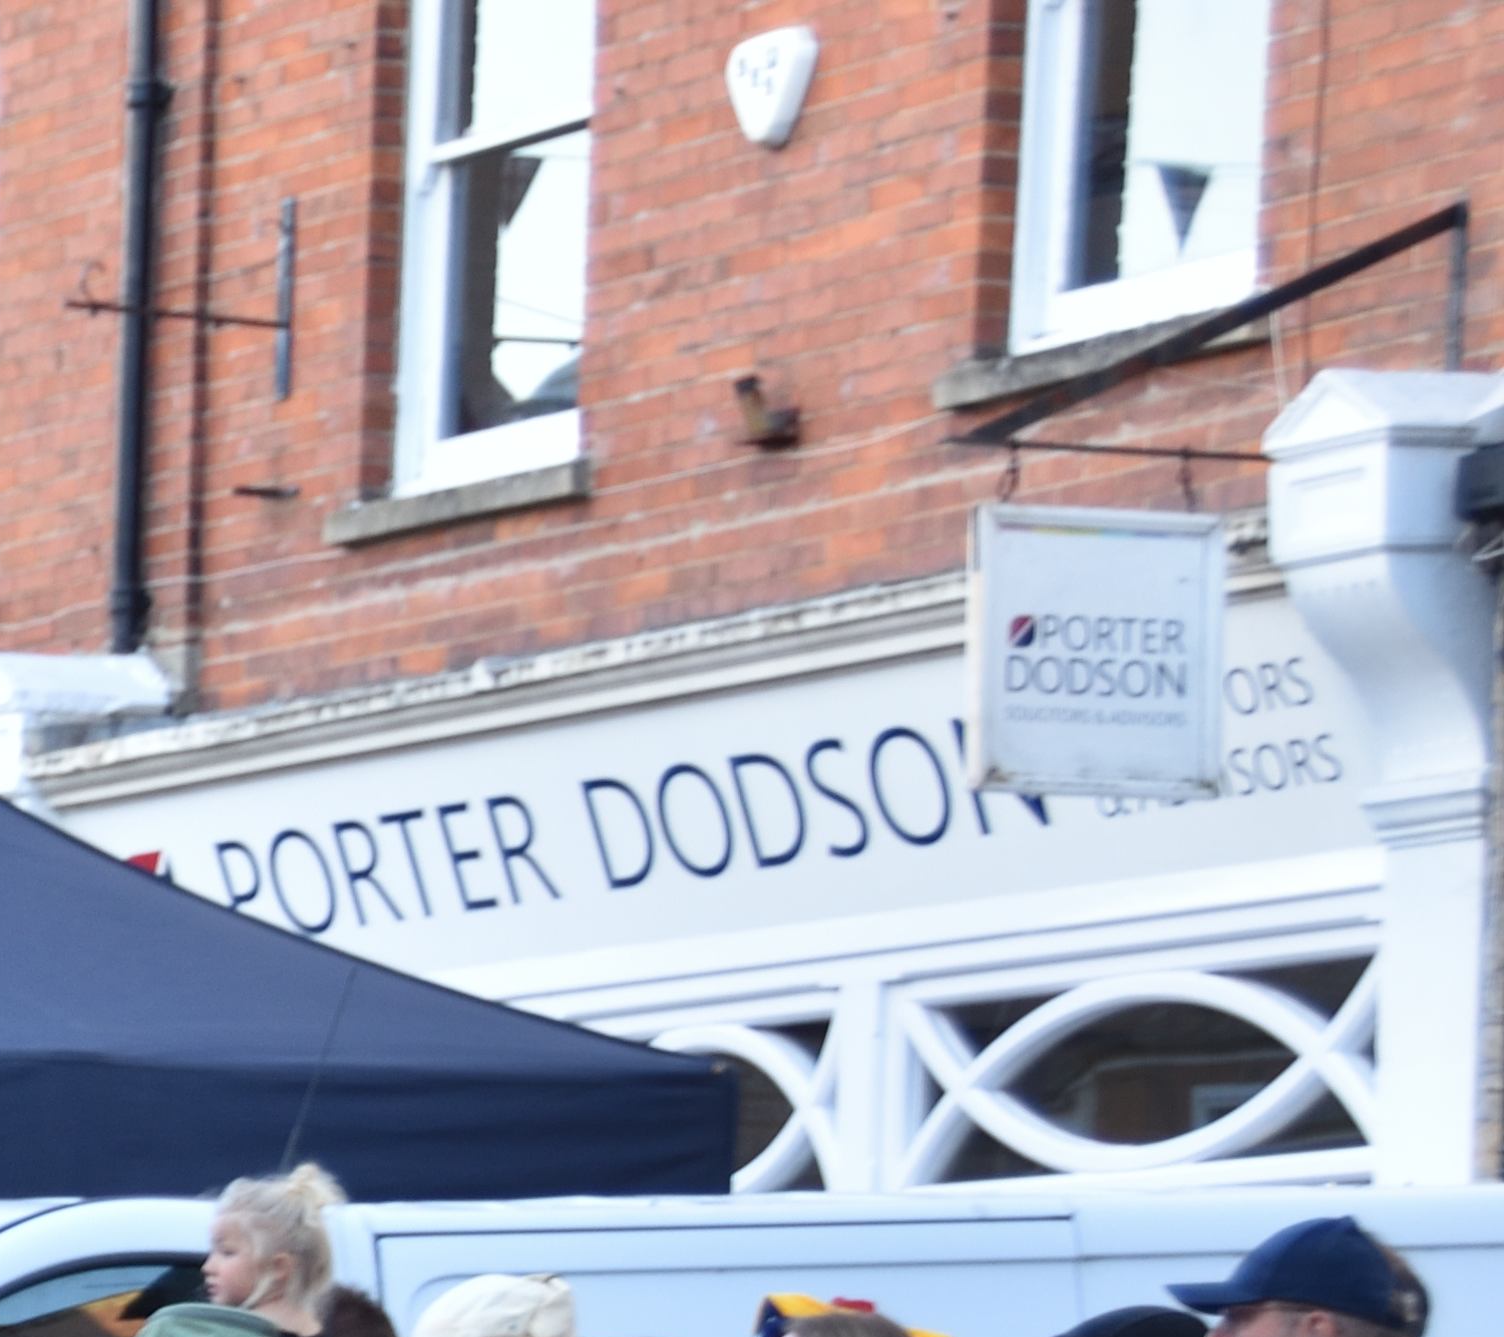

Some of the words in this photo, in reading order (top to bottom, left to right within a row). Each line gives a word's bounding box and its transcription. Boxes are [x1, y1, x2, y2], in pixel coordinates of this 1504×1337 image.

[1038, 613, 1186, 653] PORTER
[1003, 654, 1187, 698] DODSON
[216, 795, 562, 936] PORTER
